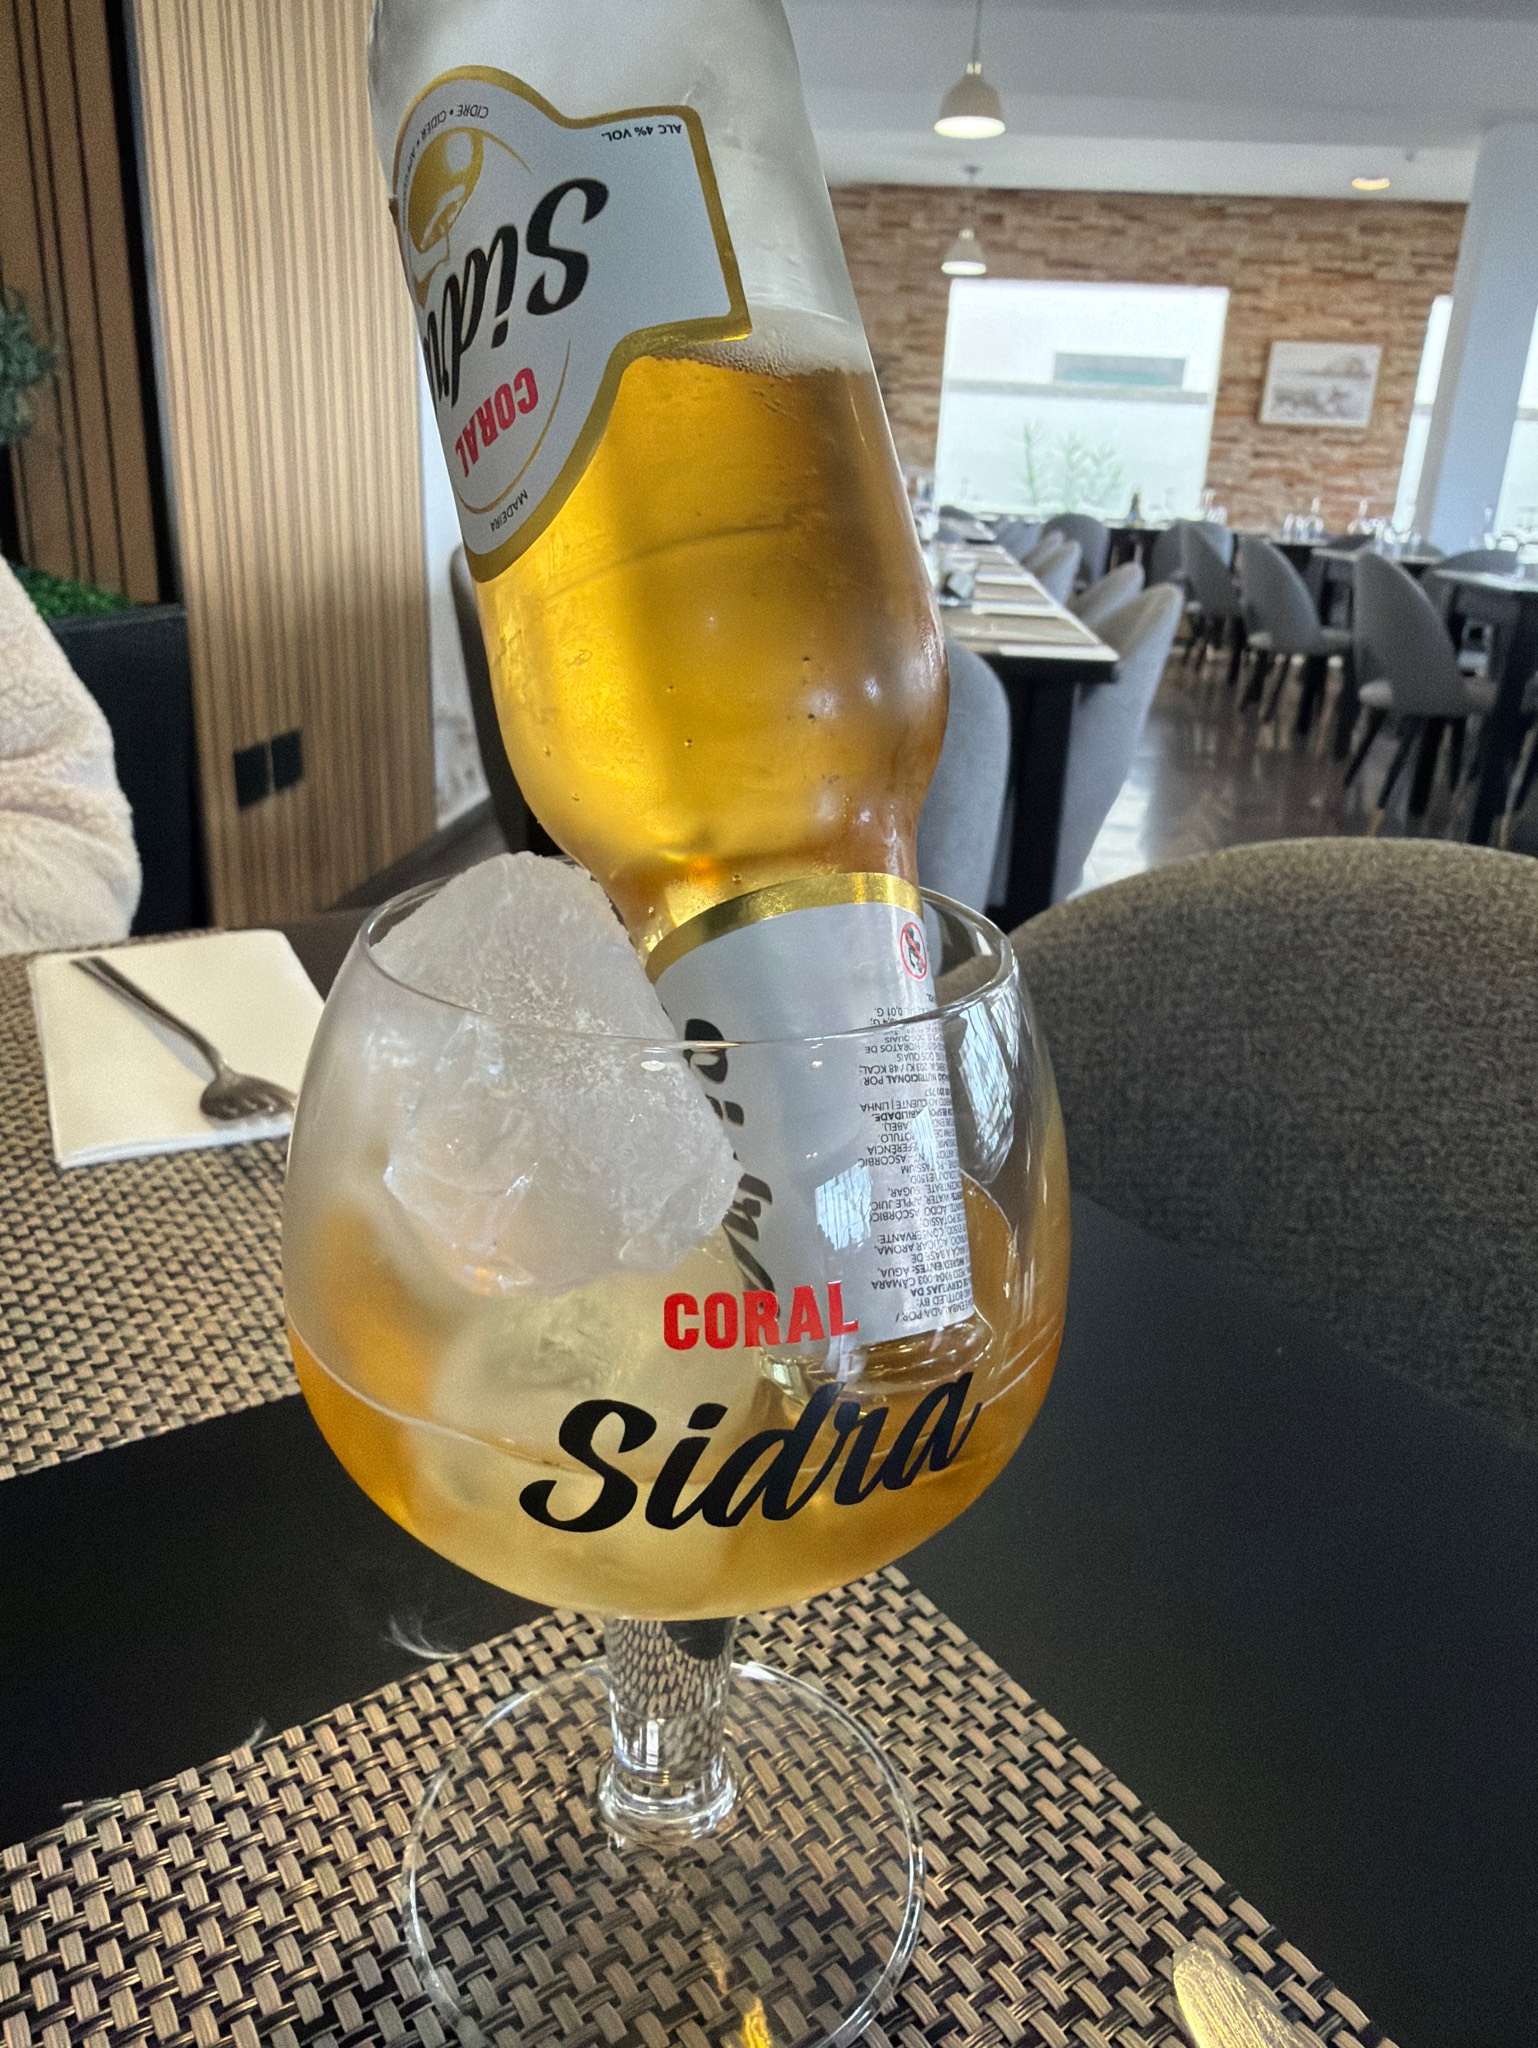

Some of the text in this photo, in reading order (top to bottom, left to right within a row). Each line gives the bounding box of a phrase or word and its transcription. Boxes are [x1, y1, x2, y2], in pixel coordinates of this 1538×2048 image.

[420, 104, 489, 141] CIDRE CIDER
[601, 122, 683, 142] ALC 4% VOL.
[455, 367, 539, 478] CORAL
[490, 488, 529, 533] MADEIRA
[874, 1008, 884, 1016] G.
[887, 1007, 902, 1016] 0,01
[889, 1064, 898, 1072] 48
[863, 1076, 884, 1085] POR
[860, 1102, 889, 1112] LINHA
[896, 1098, 927, 1109] CLIENTE
[877, 1132, 914, 1143] ÓTULO.
[857, 1155, 907, 1167] ASCORBIC
[870, 1200, 892, 1210] JUIC
[874, 1243, 914, 1255] AROMA,
[911, 1253, 924, 1264] DE
[877, 1267, 910, 1278] ÁGUA,
[871, 1276, 916, 1290] CÂMARA
[910, 1288, 924, 1296] DA
[916, 1297, 930, 1307] BY:
[663, 1281, 859, 1351] CORAL
[902, 1309, 922, 1322] POR
[519, 1372, 982, 1532] Sidra
